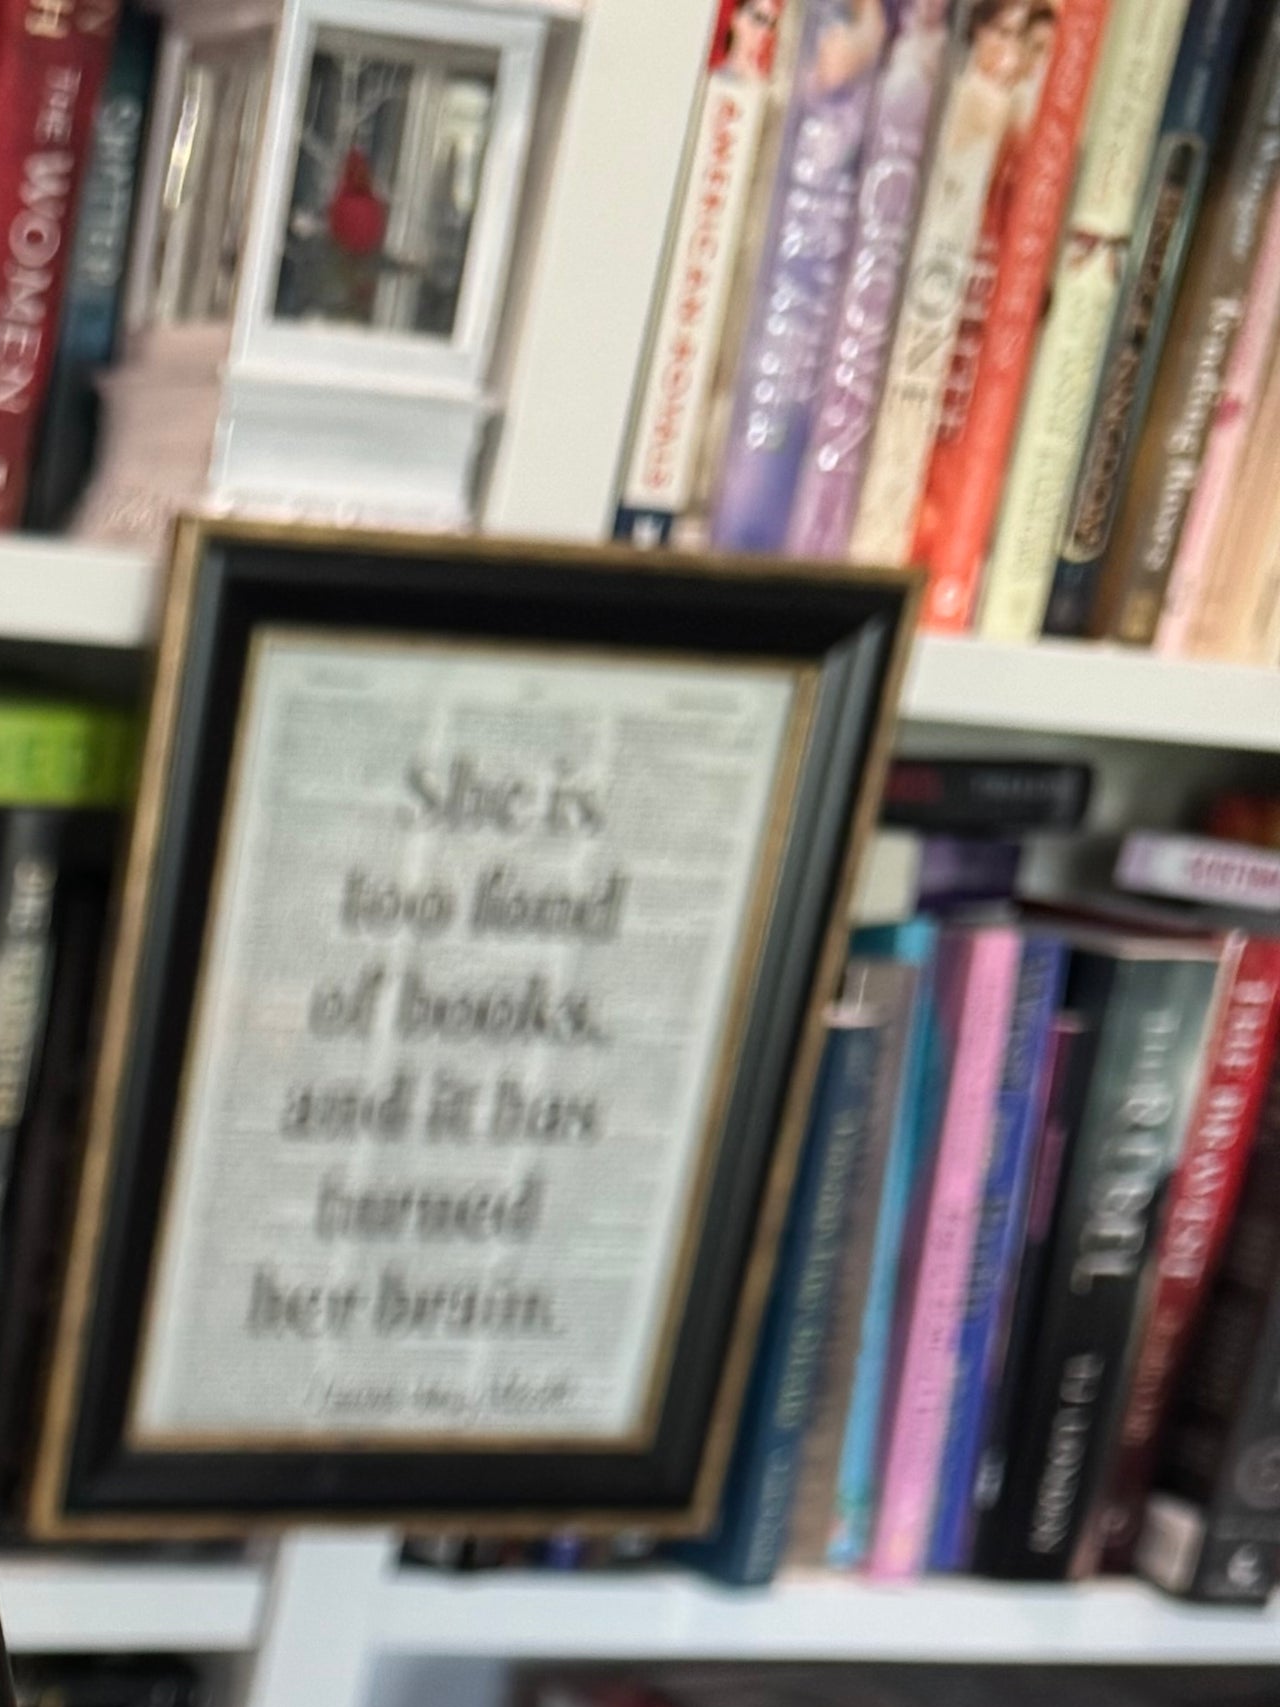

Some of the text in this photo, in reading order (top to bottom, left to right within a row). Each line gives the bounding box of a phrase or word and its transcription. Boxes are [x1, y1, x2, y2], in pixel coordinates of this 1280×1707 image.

[35, 64, 82, 142] THE
[670, 98, 740, 324] AMERICAN
[394, 752, 607, 836] She is
[341, 861, 632, 941] too fond
[307, 960, 387, 1040] of
[279, 1066, 602, 1147] and it has
[246, 1260, 360, 1341] her
